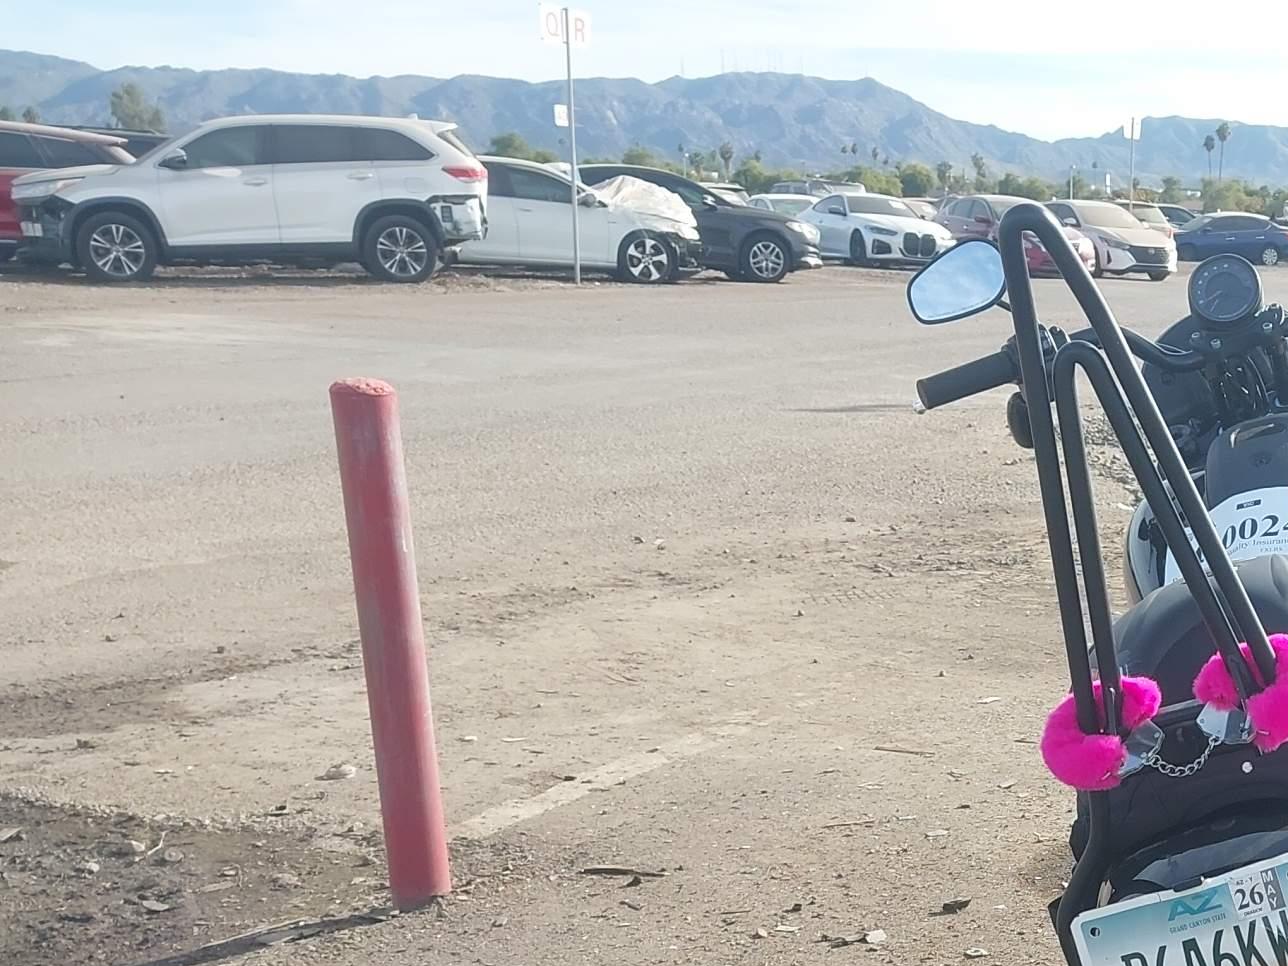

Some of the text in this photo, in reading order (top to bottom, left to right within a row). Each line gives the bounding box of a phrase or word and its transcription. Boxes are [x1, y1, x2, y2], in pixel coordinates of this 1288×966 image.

[545, 12, 560, 37] Q
[574, 17, 585, 42] R
[1233, 882, 1264, 911] 26
[1261, 869, 1278, 908] MAY
[1168, 888, 1223, 922] AZ
[1169, 912, 1227, 935] GRAND CANYON STATE
